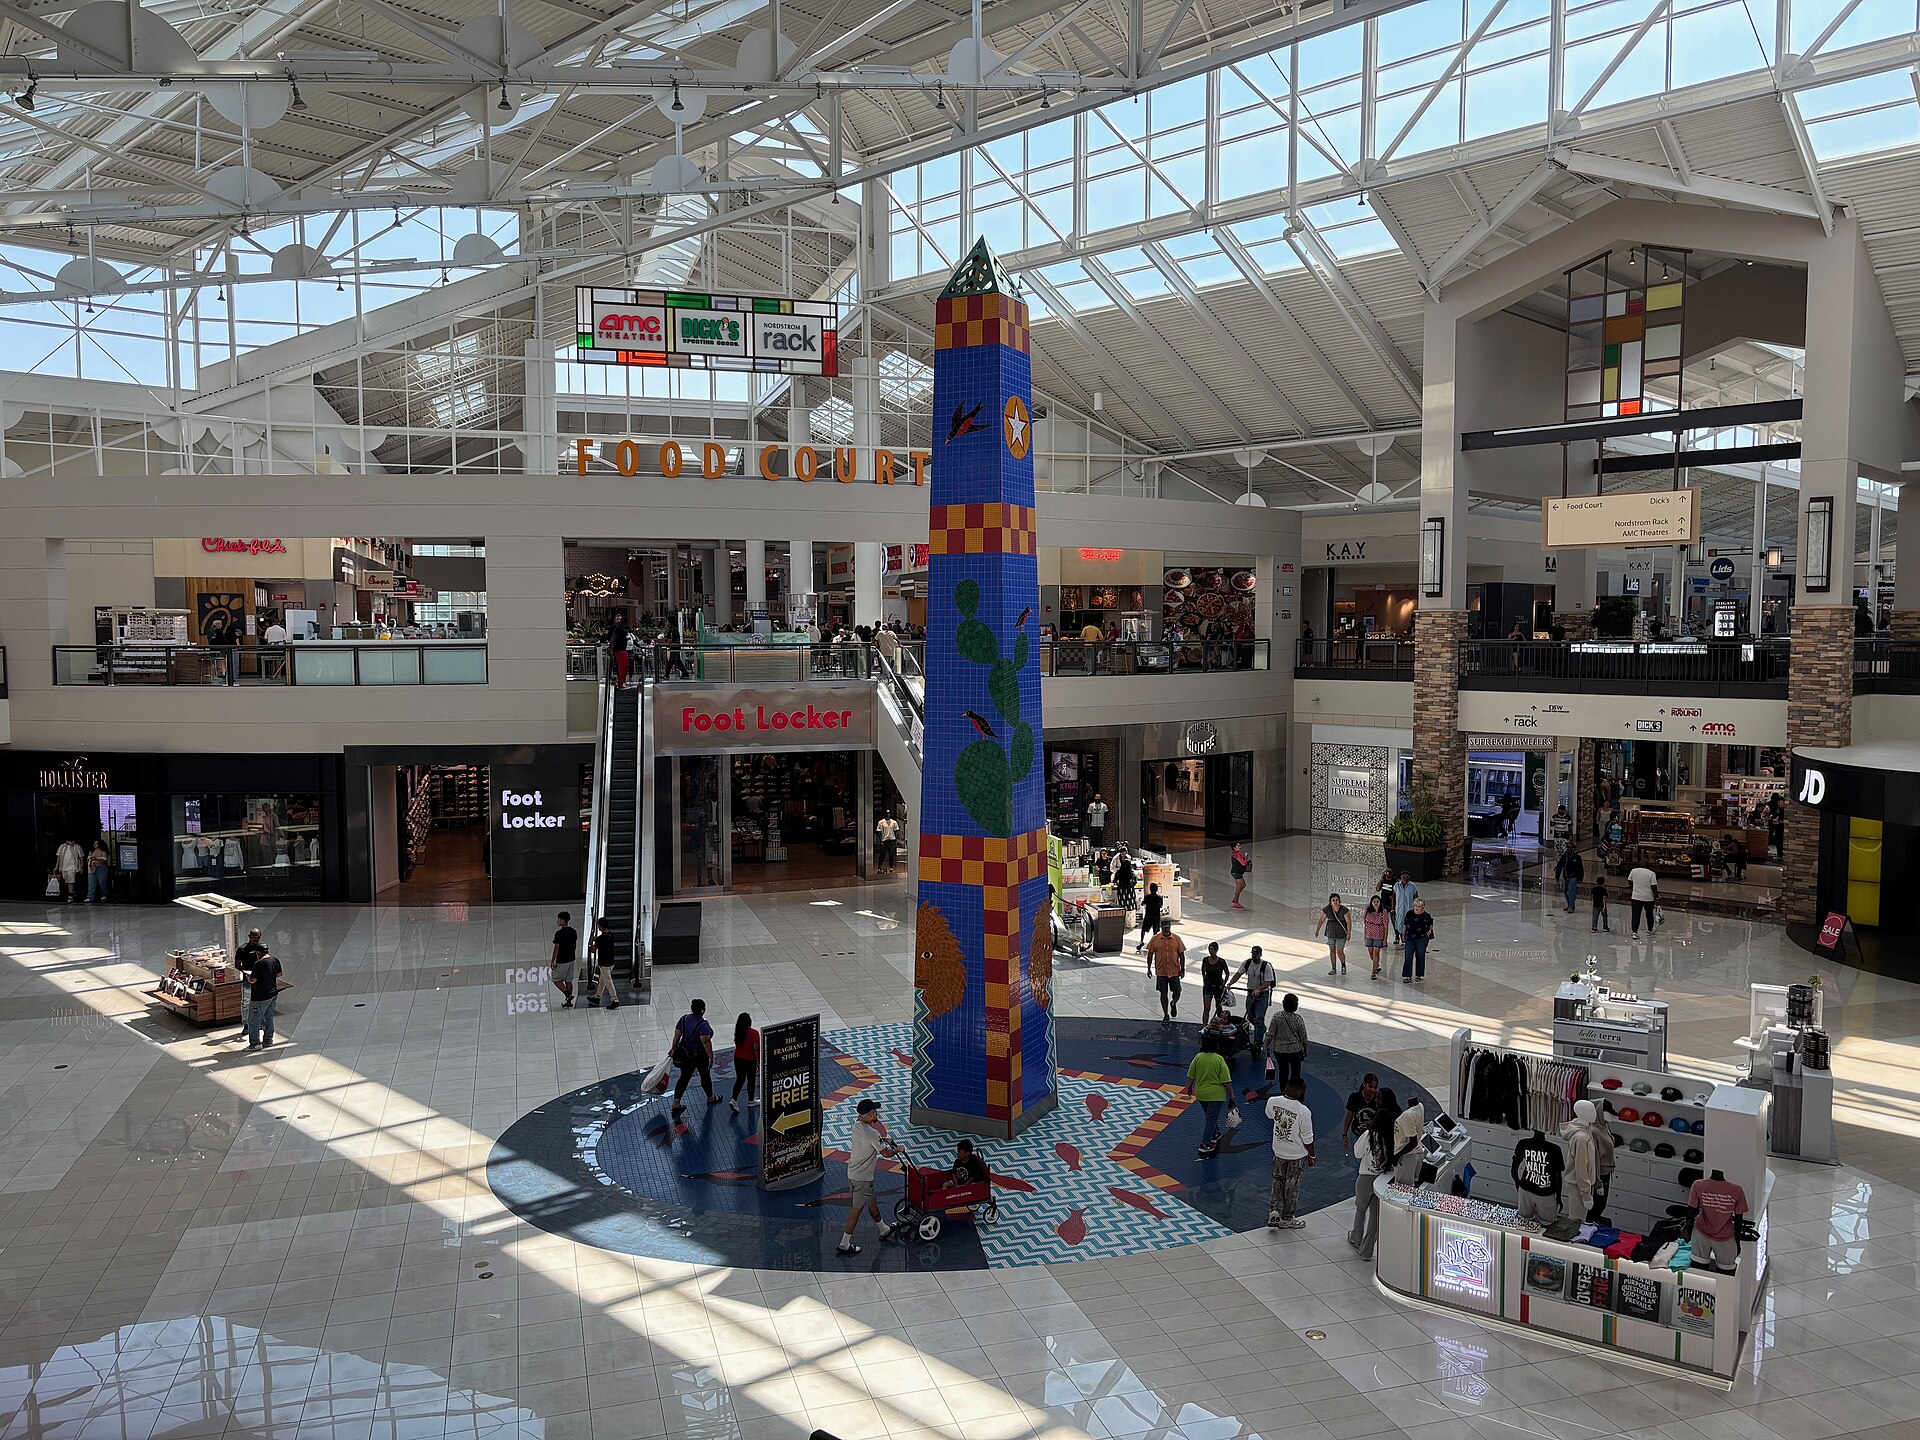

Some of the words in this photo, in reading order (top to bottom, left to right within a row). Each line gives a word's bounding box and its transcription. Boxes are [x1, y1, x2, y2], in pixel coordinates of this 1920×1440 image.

[599, 314, 661, 332] amc
[681, 316, 740, 341] DICK'S
[763, 322, 801, 330] NORDSTROM
[598, 331, 662, 342] THEATRES
[763, 325, 816, 352] rack
[576, 438, 726, 479] FOOD
[759, 444, 929, 486] COURT
[1650, 497, 1670, 505] Dick's
[1614, 518, 1651, 528] Nordstrom
[1327, 541, 1366, 556] KAY
[1545, 556, 1557, 569] KA
[1629, 561, 1650, 569] KAY
[1712, 564, 1732, 573] Lids
[1626, 578, 1639, 591] Lids
[682, 706, 746, 733] Foot
[756, 705, 852, 730] Locker
[1671, 708, 1702, 717] ROUND1
[1514, 715, 1538, 728] rack
[1637, 720, 1661, 730] DICK'S
[1702, 723, 1736, 732] amc
[1187, 735, 1217, 755] HOOPS
[1469, 737, 1510, 746] SUPREME
[1510, 737, 1553, 747] JEWELERS
[40, 770, 108, 789] HOLLISTER
[1331, 778, 1368, 788] SUPREME
[1798, 768, 1826, 805] JD
[502, 790, 543, 806] Foot
[1331, 787, 1368, 798] JEWELERS
[502, 811, 566, 829] Locker
[1822, 924, 1840, 937] SALE
[785, 1036, 797, 1045] THE
[1578, 1029, 1597, 1038] bella
[1599, 1033, 1622, 1042] terra
[773, 1041, 809, 1056] FRAGRANCE
[781, 1051, 801, 1062] STORE
[772, 1070, 789, 1080] GRAND
[783, 1072, 810, 1090] ONE
[772, 1079, 784, 1087] BUY
[772, 1085, 783, 1094] GET
[771, 1084, 810, 1109] FREE
[1524, 1149, 1550, 1165] PRAY.
[1525, 1161, 1549, 1176] WAIT.
[1525, 1170, 1551, 1186] TRUST.
[1576, 1273, 1592, 1305] OVER
[1623, 1278, 1650, 1292] PURPOSE
[1591, 1278, 1609, 1308] FEAR
[1622, 1290, 1640, 1300] GOD'S
[1640, 1296, 1657, 1304] PLAN
[1624, 1296, 1654, 1311] PREVAILS.
[1677, 1287, 1716, 1315] PURPOSE
